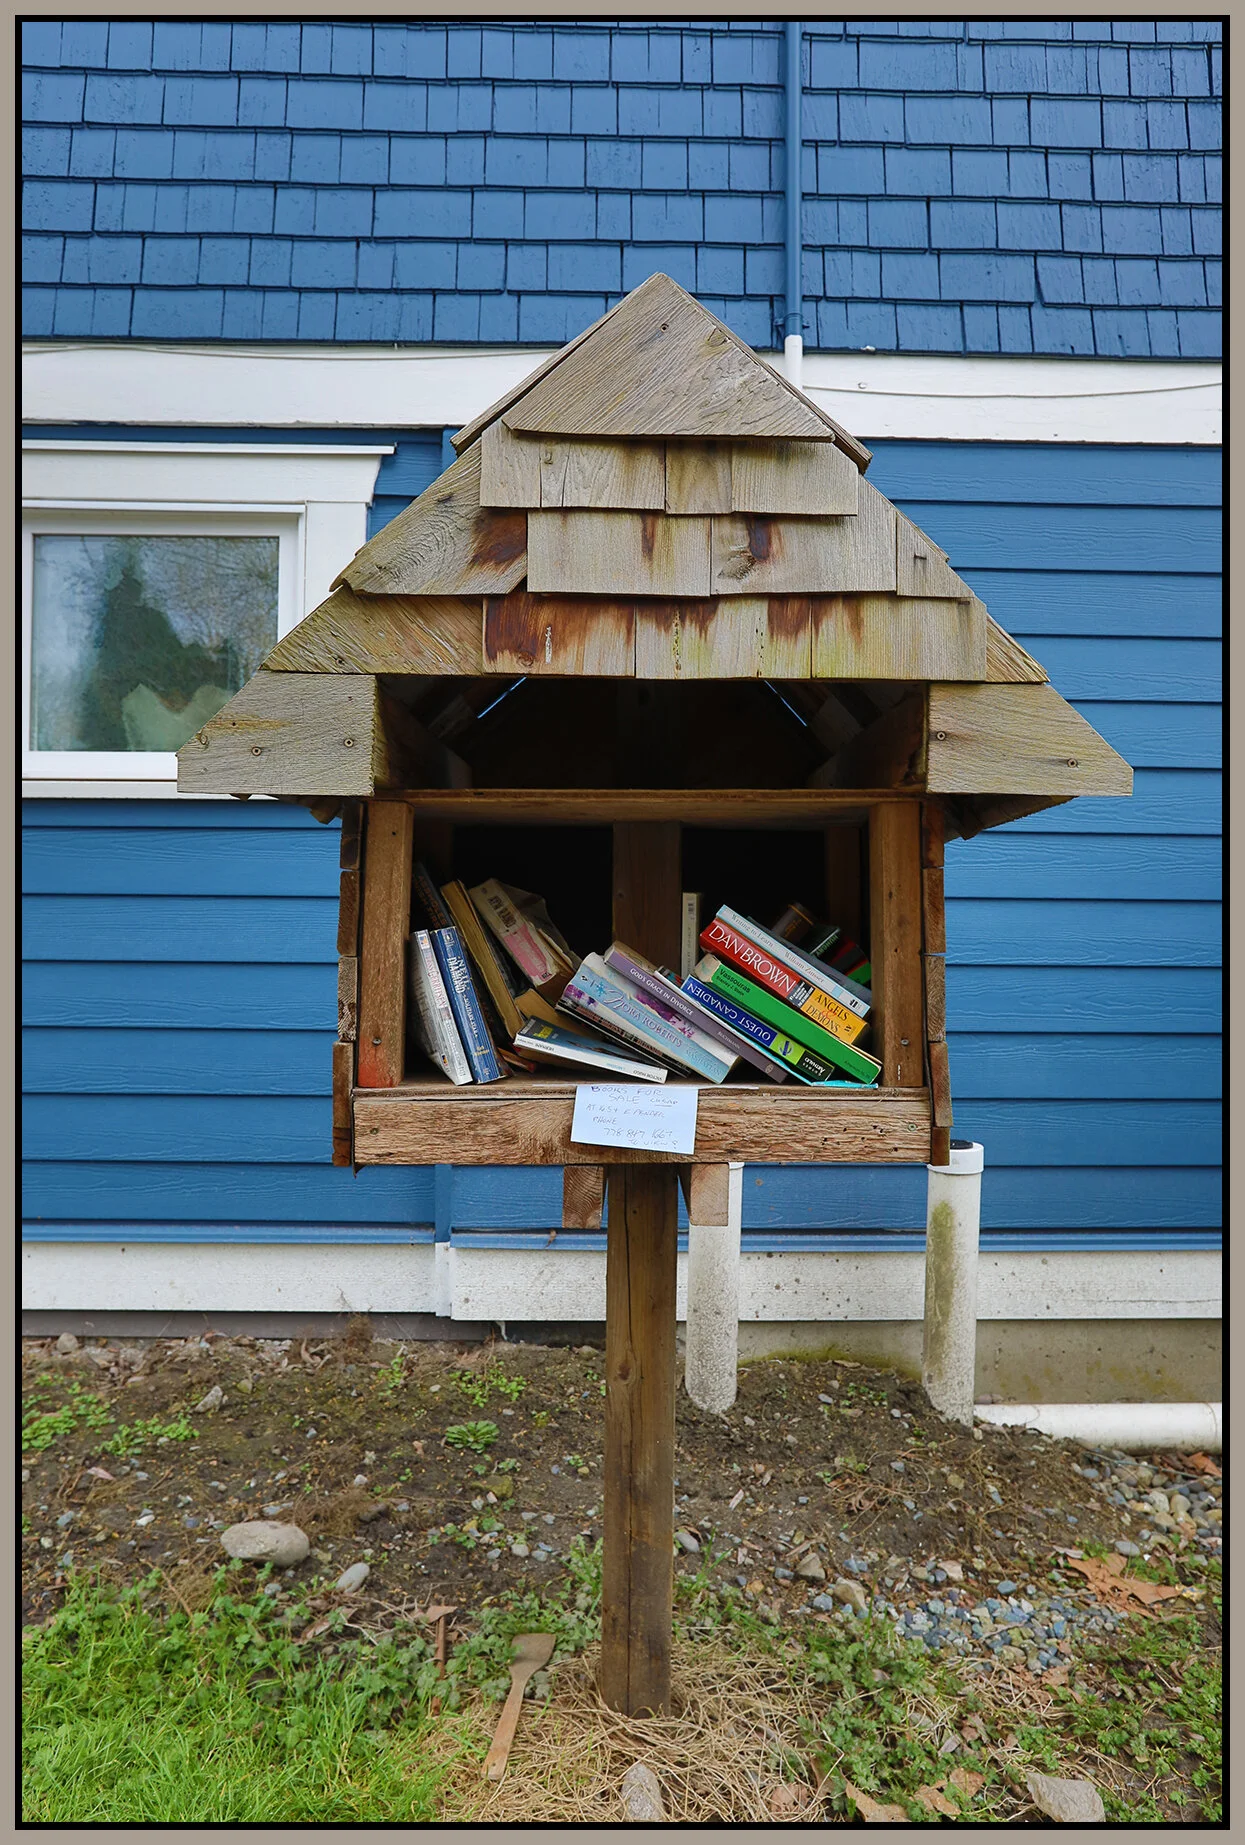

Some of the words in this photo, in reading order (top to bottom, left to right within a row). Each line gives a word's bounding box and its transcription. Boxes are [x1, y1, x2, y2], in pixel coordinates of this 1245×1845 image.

[732, 914, 751, 934] Writing
[757, 932, 774, 947] Learn
[784, 951, 805, 969] William
[708, 925, 740, 955] DAN
[740, 948, 797, 993] BROWN
[447, 957, 465, 994] DIAMOND
[719, 968, 751, 994] Vassouras
[629, 968, 647, 982] GOD'S
[646, 978, 663, 994] GRACE
[669, 995, 694, 1016] DIVORCE
[687, 982, 738, 1019] CANADIEN
[602, 990, 641, 1021] NORA
[641, 1011, 683, 1047] ROBERTS
[805, 1004, 841, 1033] DEMONS
[815, 994, 851, 1022] ANGELS
[738, 1015, 771, 1042] OUEST
[591, 1086, 628, 1095] BOOKS
[637, 1088, 664, 1096] FOR
[608, 1094, 640, 1105] SALE
[592, 1115, 617, 1125] PHONE
[604, 1127, 622, 1137] 778
